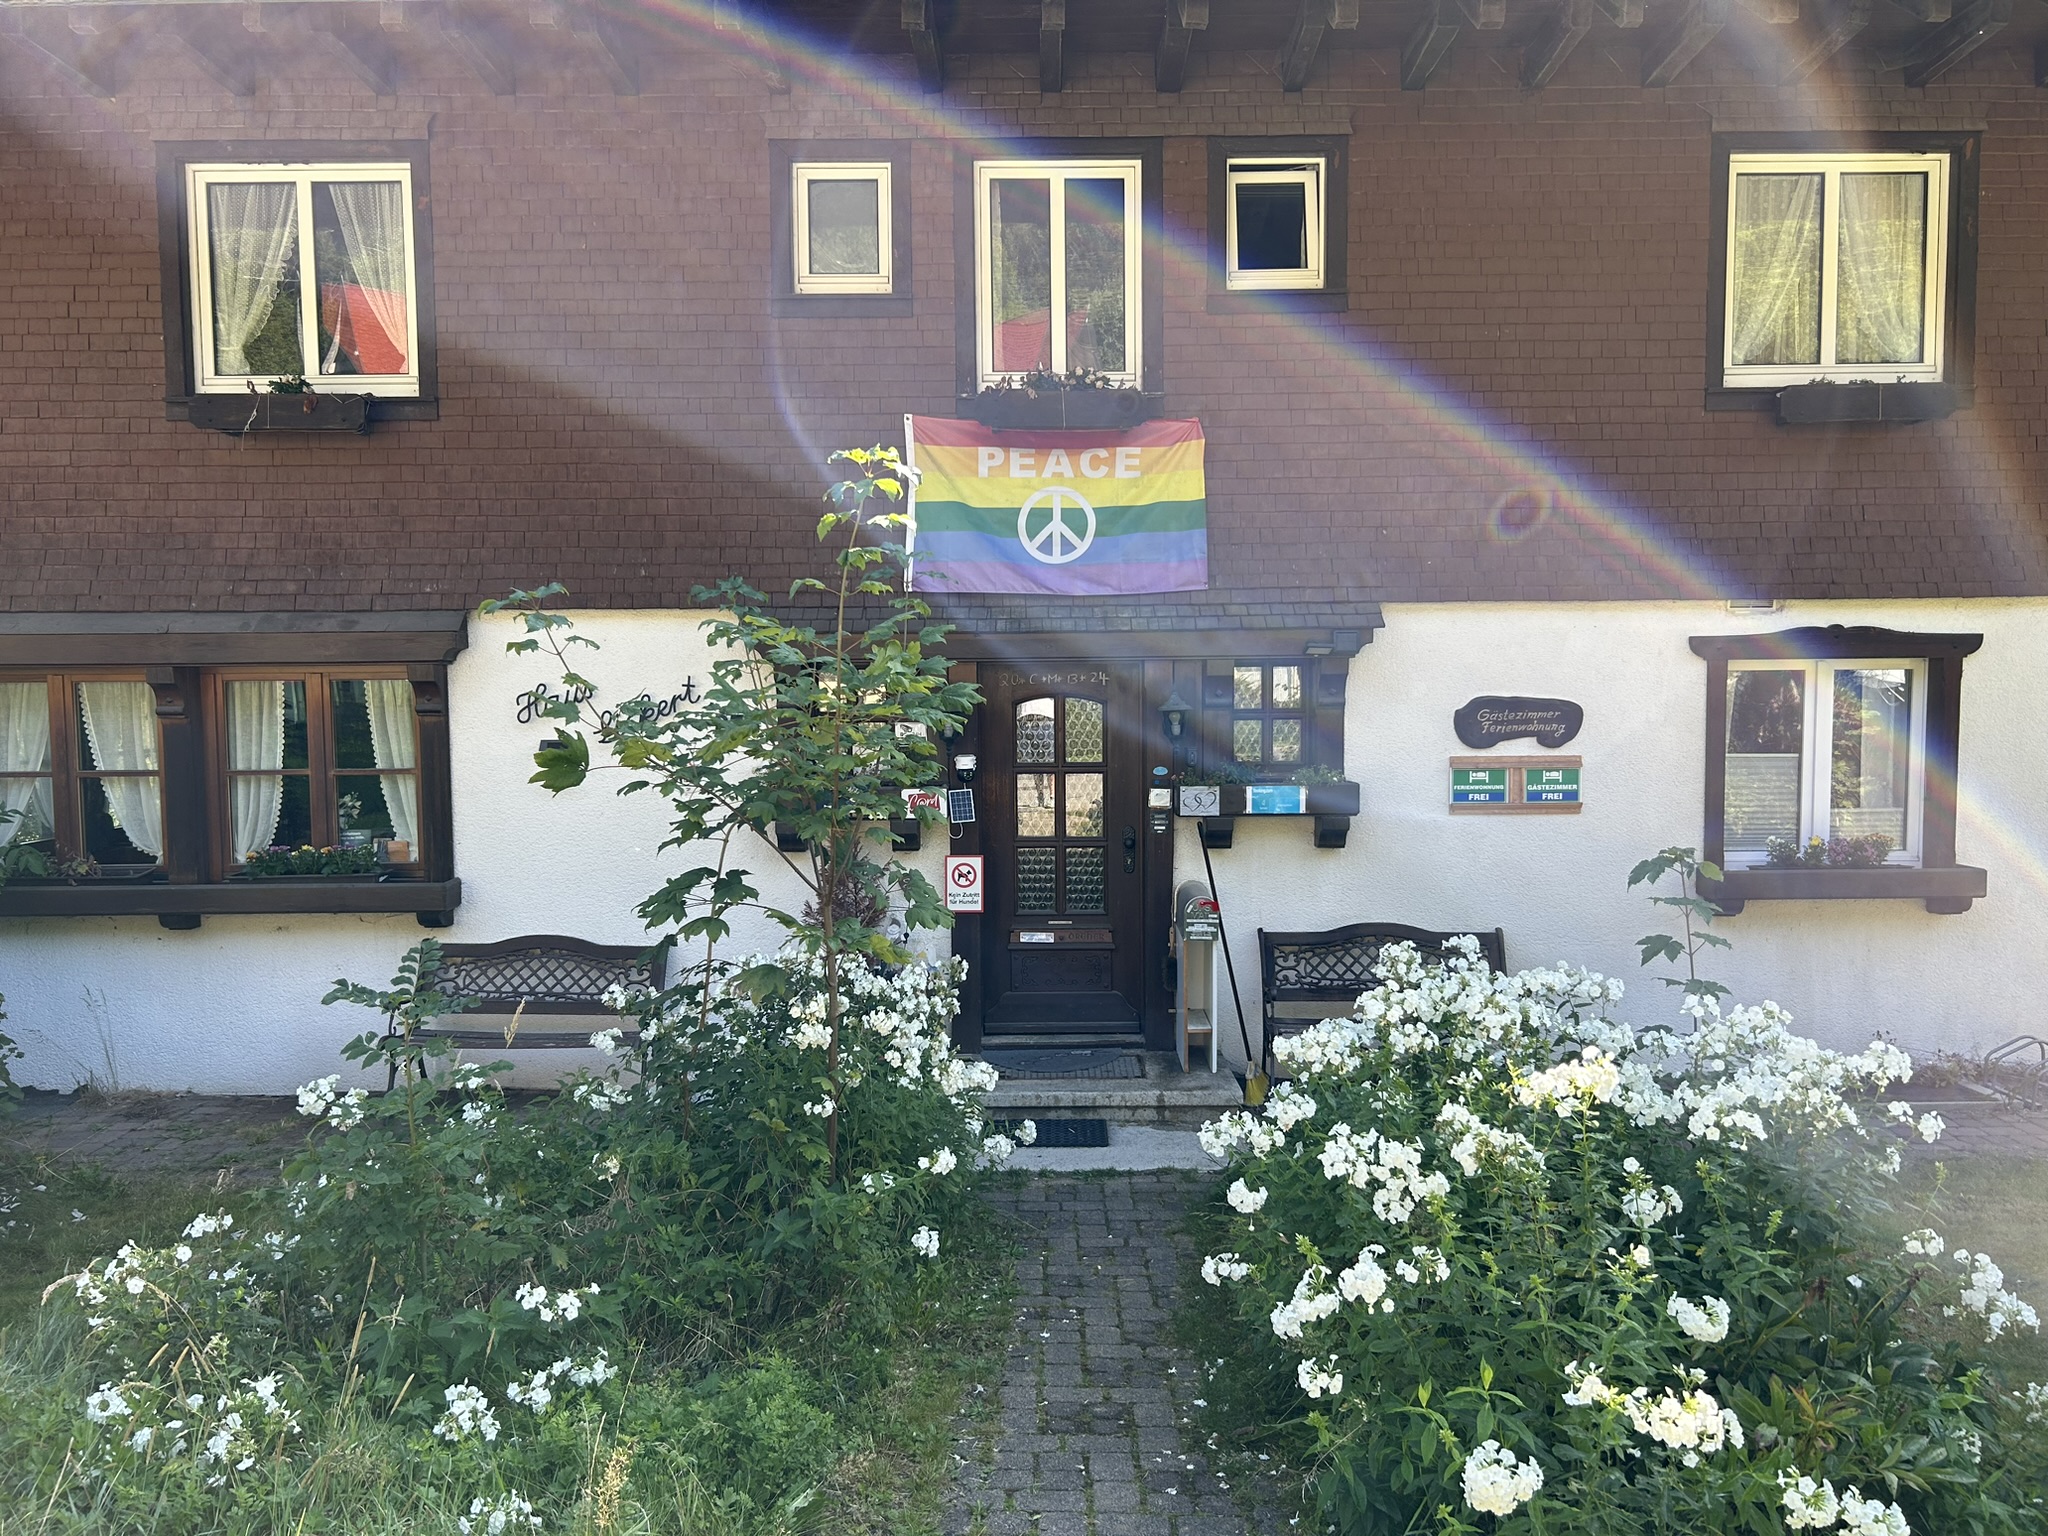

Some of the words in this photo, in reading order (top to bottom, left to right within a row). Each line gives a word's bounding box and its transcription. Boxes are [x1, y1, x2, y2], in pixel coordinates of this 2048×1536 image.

[977, 446, 1142, 479] PEACE
[516, 683, 594, 724] Haus
[1477, 708, 1561, 722] Gästezimmer
[1481, 720, 1566, 738] Ferienwohnung
[1468, 793, 1490, 801] FREI
[1541, 792, 1563, 800] FREI
